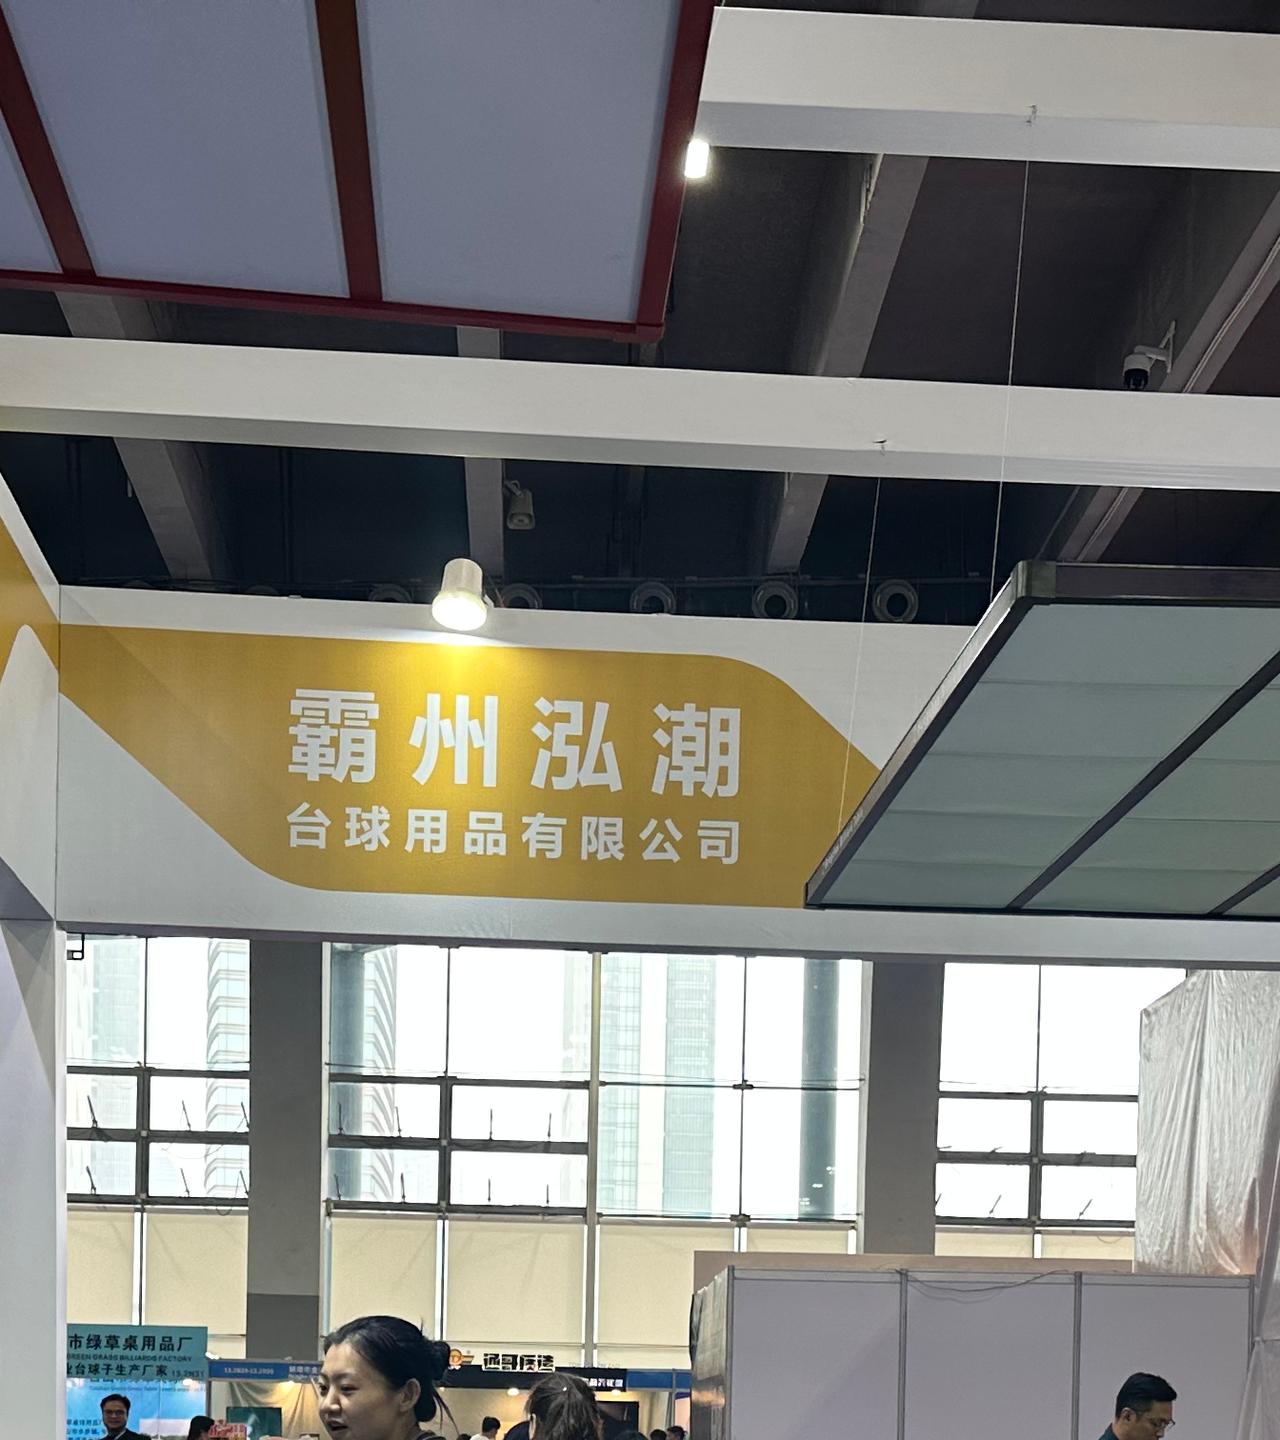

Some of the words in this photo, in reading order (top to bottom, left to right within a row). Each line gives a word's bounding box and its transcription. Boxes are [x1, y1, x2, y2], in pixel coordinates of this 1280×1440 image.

[286, 688, 741, 799] 霸州泓潮
[285, 801, 740, 866] 台球用品有限公司
